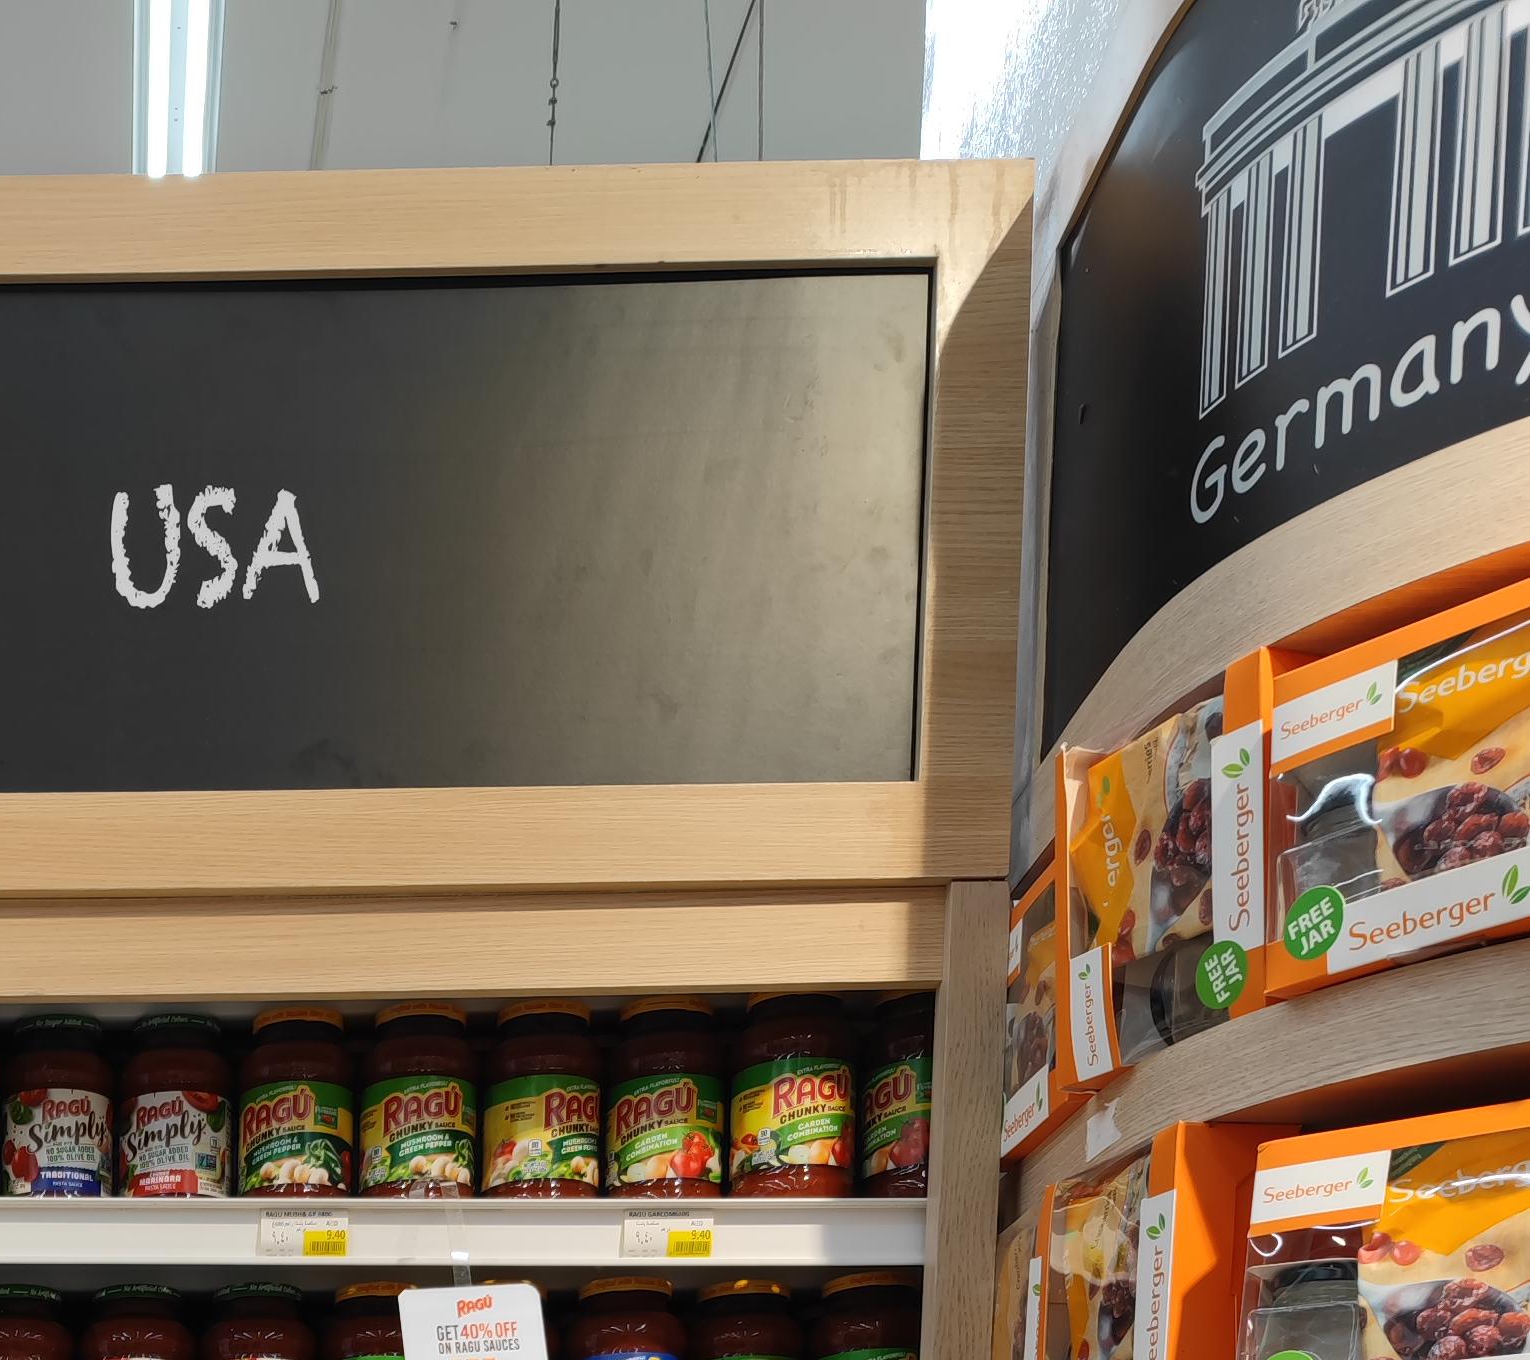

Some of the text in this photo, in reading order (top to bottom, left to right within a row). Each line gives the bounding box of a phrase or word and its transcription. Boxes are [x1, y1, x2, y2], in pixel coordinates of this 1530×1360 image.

[111, 484, 320, 609] USA
[1280, 696, 1363, 740] Seeberger
[1287, 899, 1334, 941] FREE
[1300, 920, 1336, 955] JAR
[1350, 892, 1496, 951] Seeberger
[1206, 953, 1229, 1002] FREE
[1223, 947, 1244, 983] JAR
[1087, 983, 1099, 1067] Seeberger
[772, 1068, 850, 1105] RAGÚ
[613, 1087, 695, 1131] RAGÚ
[780, 1107, 825, 1123] CHUNKY
[40, 1171, 93, 1181] TRADITIONAL
[1263, 1180, 1352, 1204] Seeberger
[326, 1231, 346, 1239] 9.40
[691, 1230, 711, 1239] 9.40
[437, 1322, 517, 1341] GET 40% OFF
[439, 1339, 520, 1354] ON RAGU SAUCES
